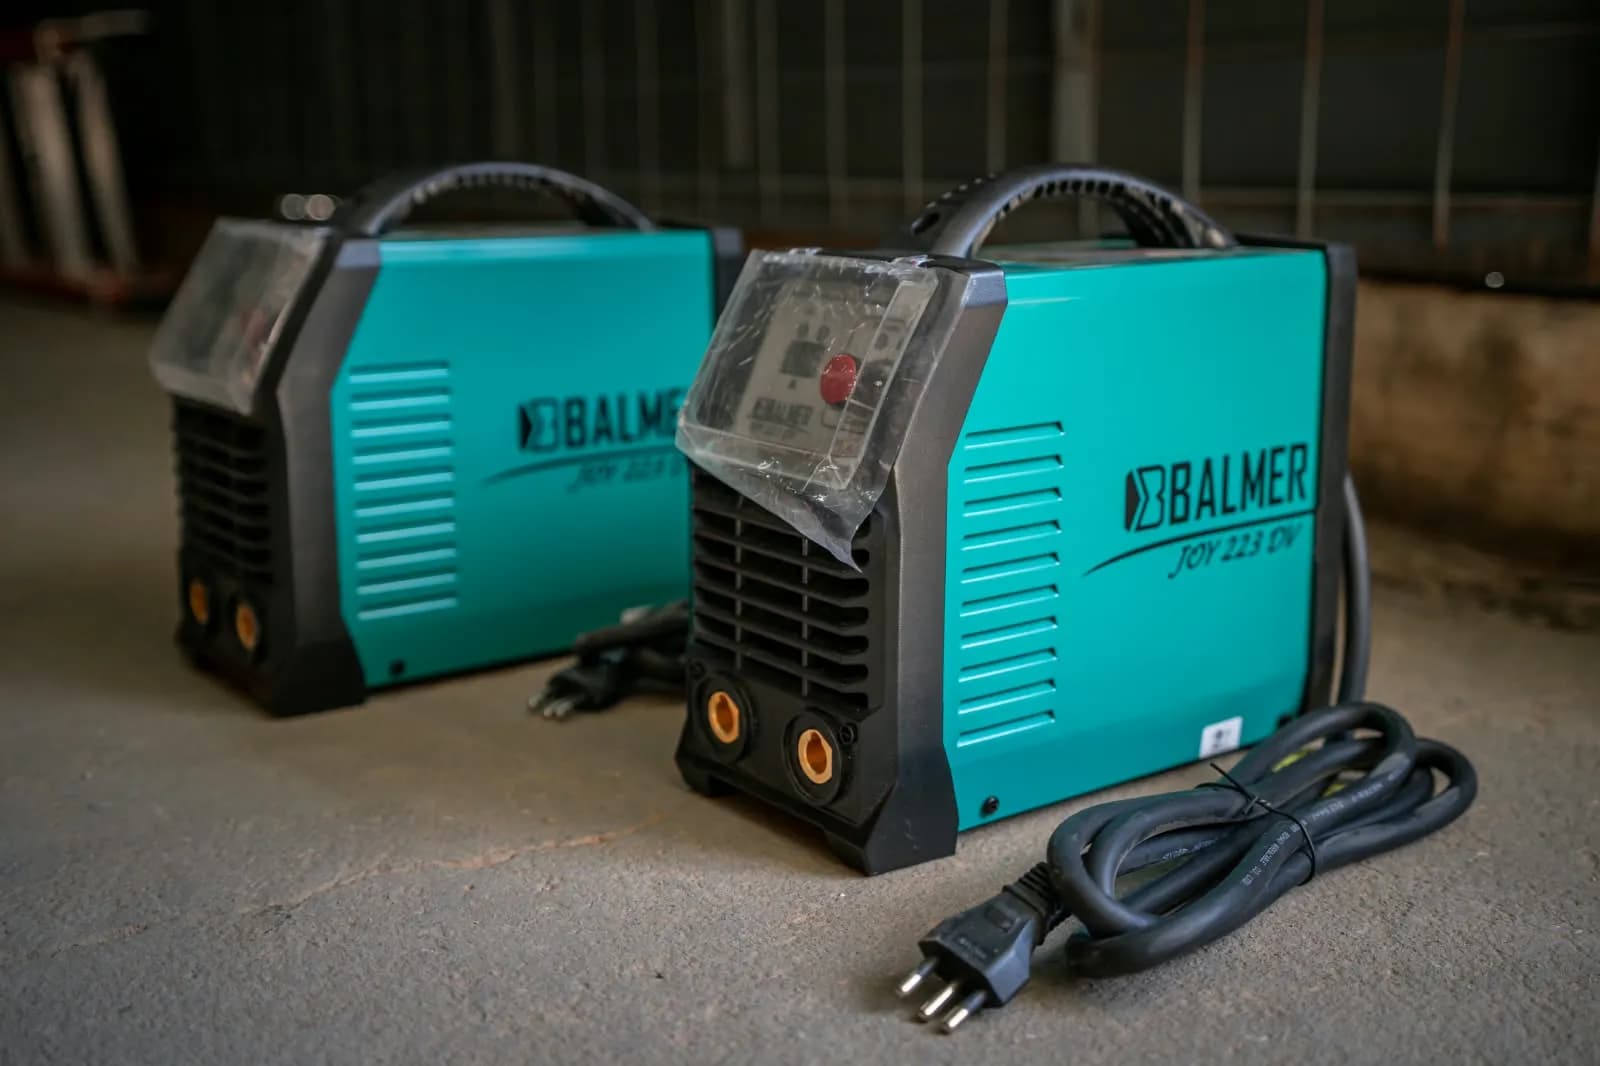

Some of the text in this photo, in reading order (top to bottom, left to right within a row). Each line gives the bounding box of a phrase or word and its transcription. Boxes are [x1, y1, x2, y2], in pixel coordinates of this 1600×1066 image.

[563, 384, 689, 448] BALME
[1168, 442, 1308, 526] BALMER
[1167, 539, 1223, 580] JOY
[1221, 530, 1265, 563] 223
